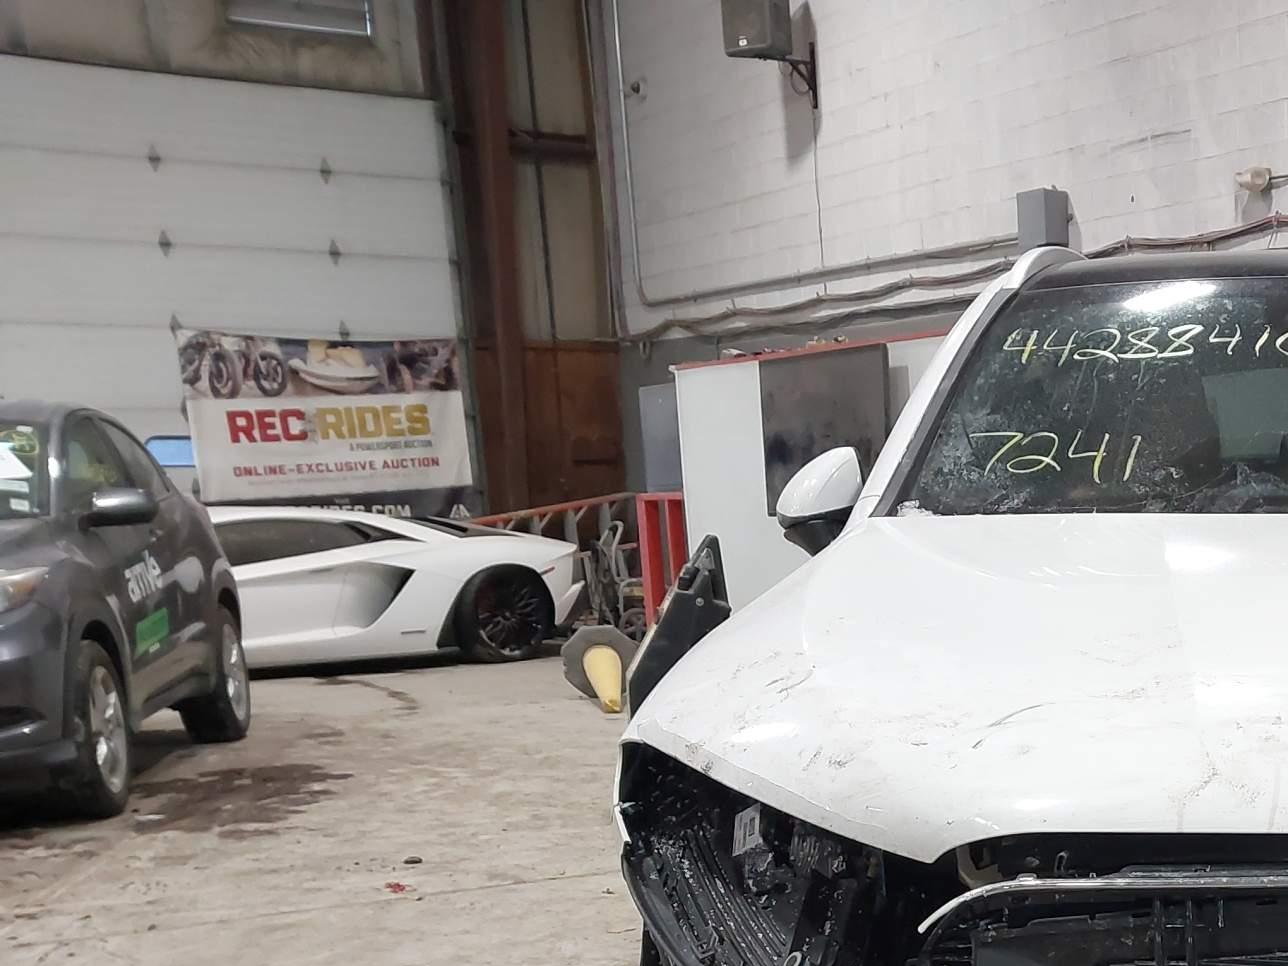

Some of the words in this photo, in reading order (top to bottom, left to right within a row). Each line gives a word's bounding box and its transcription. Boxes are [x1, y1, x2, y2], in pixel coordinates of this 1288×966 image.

[225, 407, 309, 444] REC
[315, 402, 432, 440] RIDES
[232, 460, 377, 478] ONLINE-EXCLUSIVE
[381, 456, 440, 471] AUCTION
[968, 427, 1142, 484] 7241
